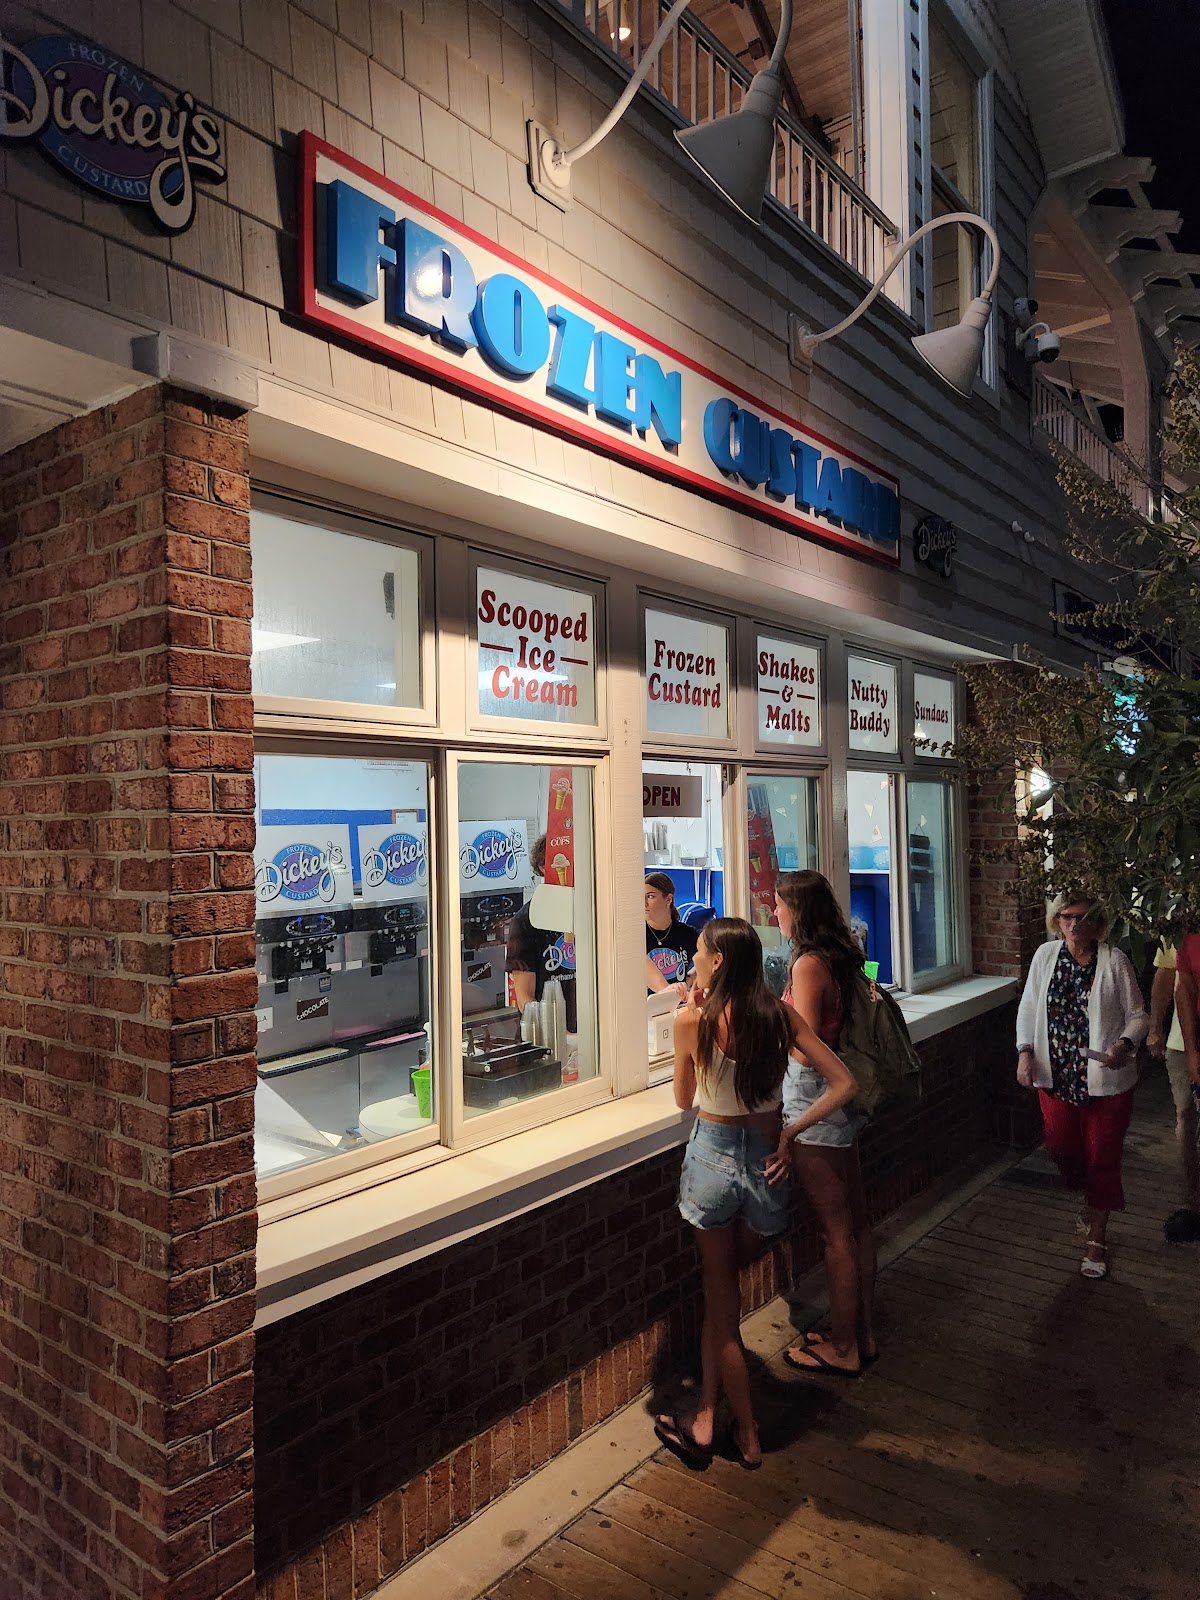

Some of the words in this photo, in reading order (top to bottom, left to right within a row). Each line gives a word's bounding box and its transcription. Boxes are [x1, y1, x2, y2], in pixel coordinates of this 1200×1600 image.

[67, 42, 144, 92] FROZEN
[0, 39, 225, 229] Dickey's
[57, 144, 149, 196] CUSTARD
[327, 178, 682, 448] FROZEN
[703, 397, 902, 540] CUSTARD
[478, 589, 588, 643] Scooped
[517, 635, 555, 672] Ice
[653, 639, 716, 677] Frozen
[757, 650, 815, 685] Shakes
[491, 665, 577, 708] Cream
[649, 673, 721, 708] Custard
[782, 685, 794, 703] &
[851, 678, 888, 709] Nutty
[765, 704, 811, 733] Malts
[849, 708, 890, 738] Buddy
[914, 700, 949, 724] Sundaes
[286, 844, 314, 854] FROZEN
[389, 834, 412, 844] FROZEN
[482, 831, 501, 839] FROZEN
[255, 841, 347, 902] Dickey's
[363, 830, 427, 887] Dickey'
[459, 828, 525, 880] Dickey's
[482, 868, 506, 877] CUSTARD
[285, 888, 320, 900] CUSTARD
[467, 961, 492, 983] CHOCOLATE
[296, 997, 329, 1021] CHOCOLATE
